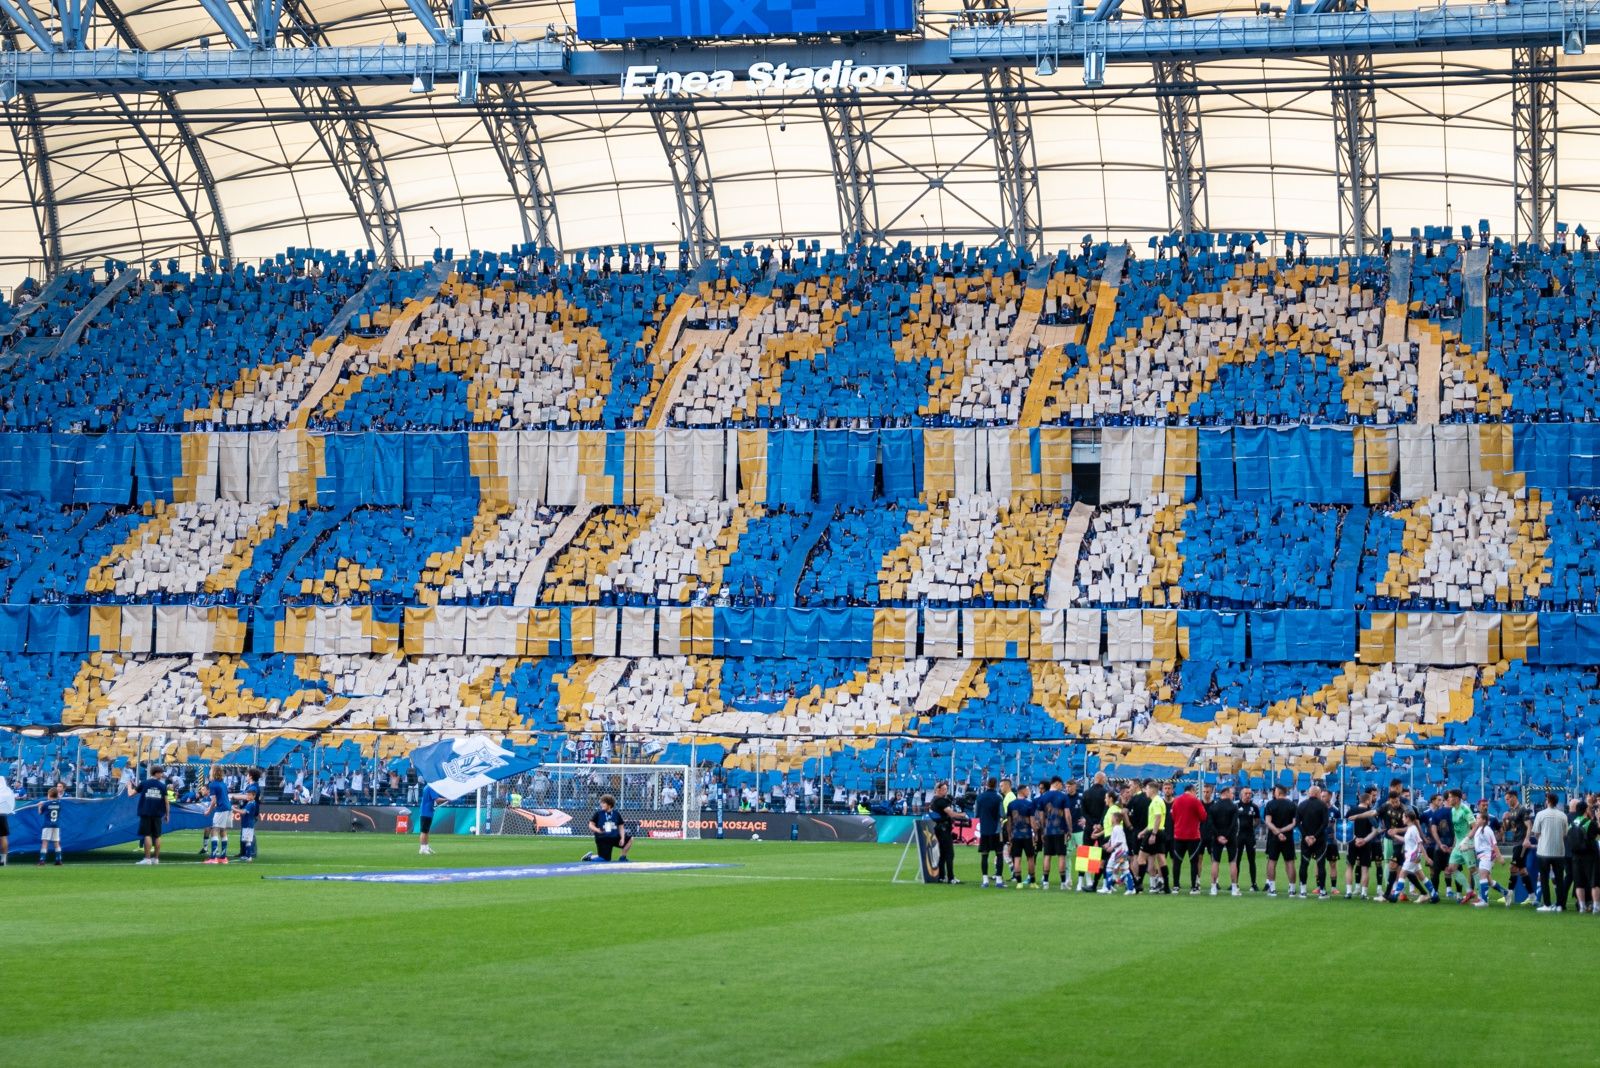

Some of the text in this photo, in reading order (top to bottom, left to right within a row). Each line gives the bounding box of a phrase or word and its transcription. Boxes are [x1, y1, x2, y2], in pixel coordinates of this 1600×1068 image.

[624, 59, 905, 95] Enea Stadion
[50, 810, 58, 822] 9
[267, 813, 310, 824] KOSZĄCE
[722, 821, 767, 832] KOSZĄCE
